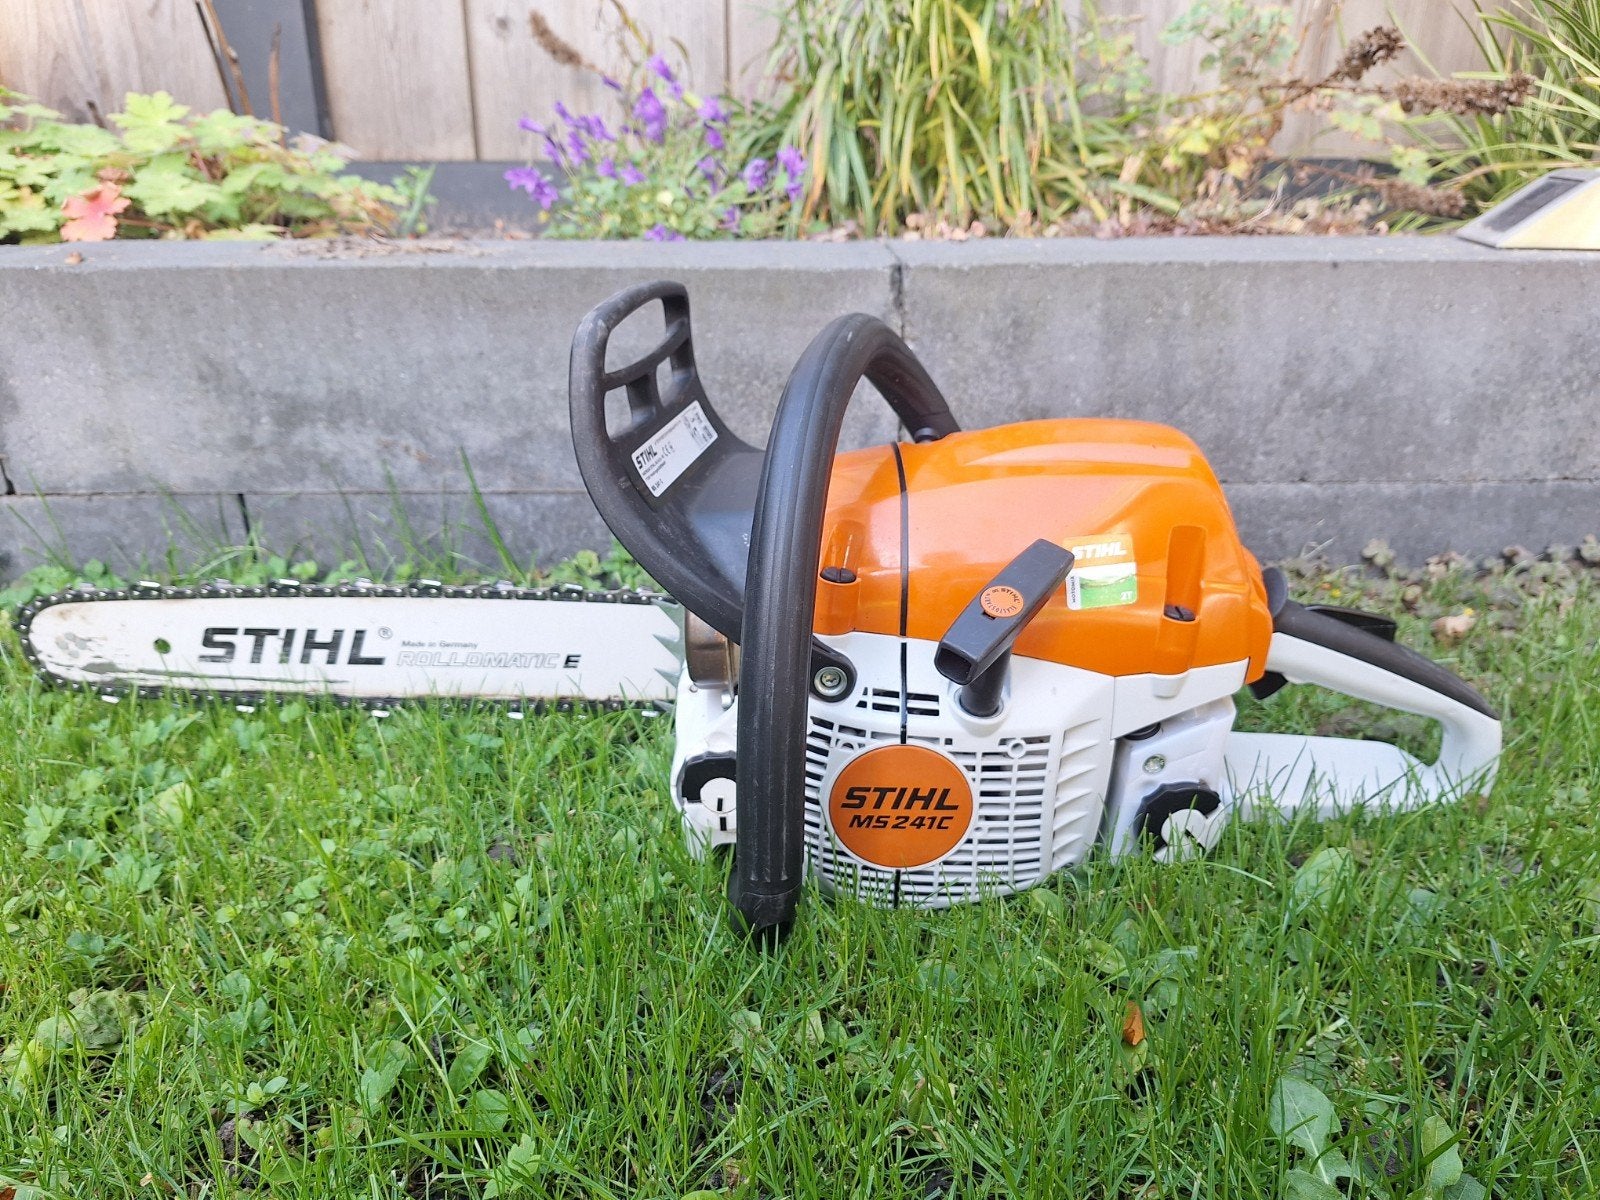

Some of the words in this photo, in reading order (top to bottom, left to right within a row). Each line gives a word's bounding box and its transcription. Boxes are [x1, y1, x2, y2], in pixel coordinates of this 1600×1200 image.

[635, 445, 658, 470] STIHL
[1072, 541, 1128, 560] STIHL
[1120, 590, 1134, 601] 2T
[401, 640, 426, 648] Made
[439, 640, 479, 649] Germany
[397, 650, 560, 668] ROLLOMATIC
[563, 654, 582, 668] E
[840, 786, 959, 811] STIHL
